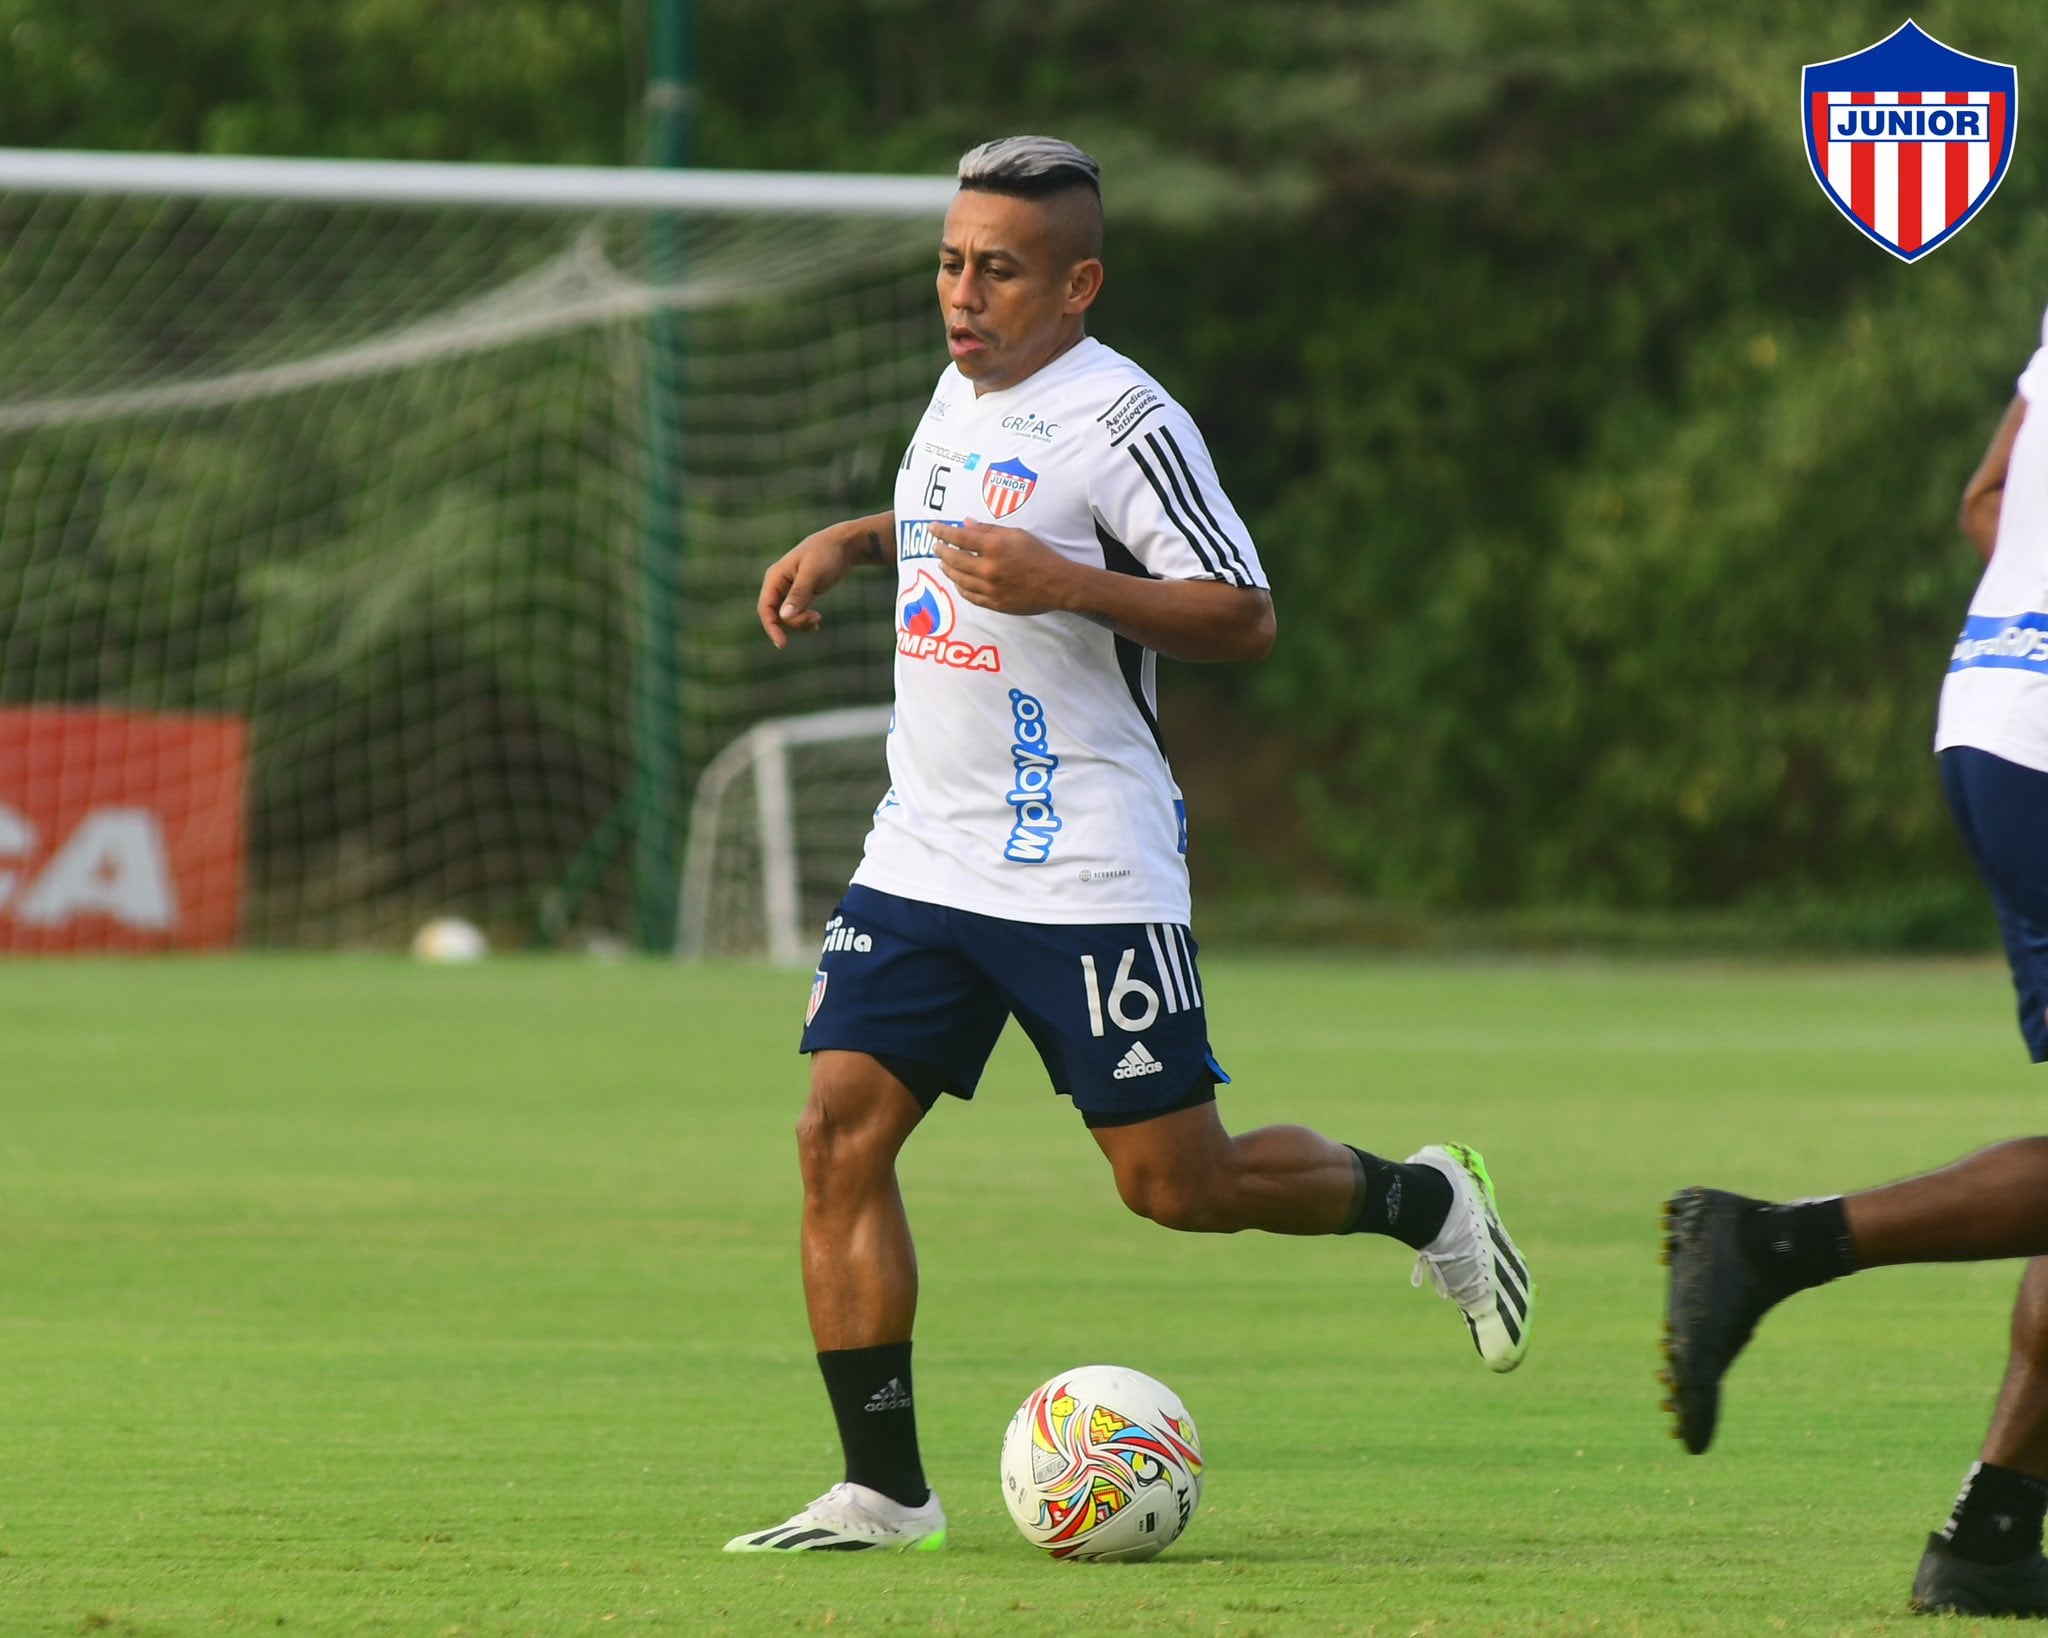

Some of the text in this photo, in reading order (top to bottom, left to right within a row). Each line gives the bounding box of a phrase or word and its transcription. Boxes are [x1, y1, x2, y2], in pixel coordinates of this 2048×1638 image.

[923, 463, 951, 512] 16
[990, 475, 1026, 492] JUNIOR
[1004, 689, 1061, 863] wplay.co
[1081, 948, 1159, 1037] 16
[1113, 1061, 1163, 1079] adidas
